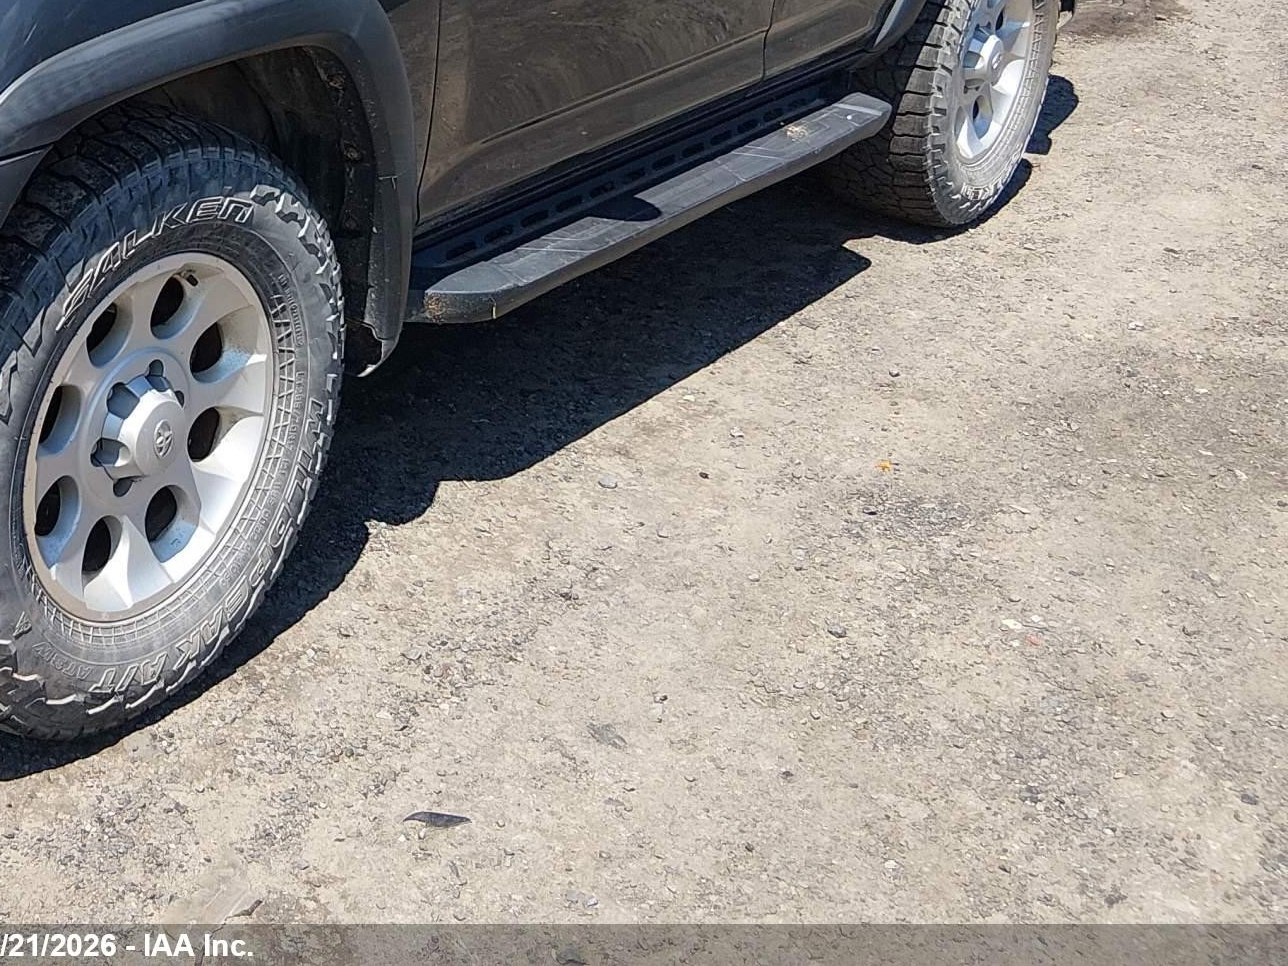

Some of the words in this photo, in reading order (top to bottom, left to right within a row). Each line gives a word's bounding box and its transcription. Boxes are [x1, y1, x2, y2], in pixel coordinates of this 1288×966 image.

[55, 196, 255, 332] FALKEN
[172, 397, 325, 672] WILDPEAK
[89, 651, 169, 694] A/T
